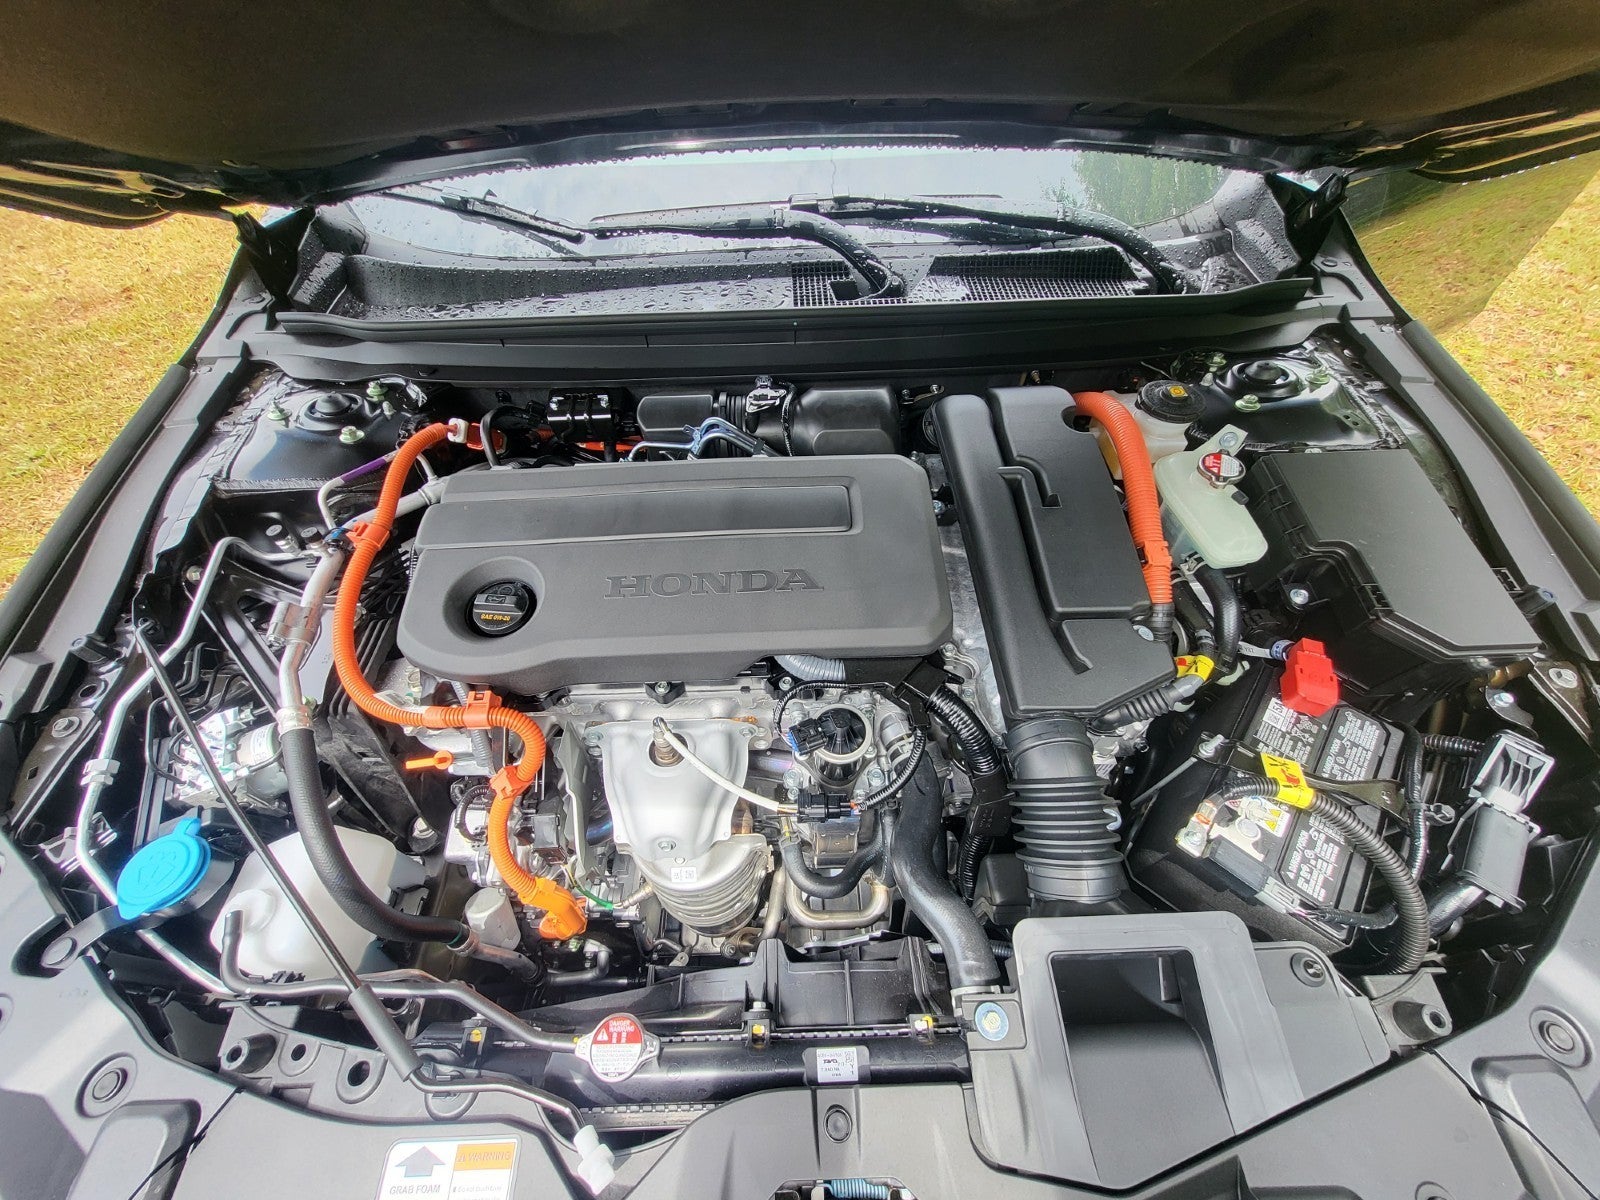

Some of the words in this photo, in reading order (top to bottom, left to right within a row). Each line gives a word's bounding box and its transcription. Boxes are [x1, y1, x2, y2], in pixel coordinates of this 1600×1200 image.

[603, 568, 825, 600] HONDA
[468, 1151, 511, 1162] WARNING
[389, 1185, 414, 1195] GRAB
[415, 1184, 441, 1194] FOAM
